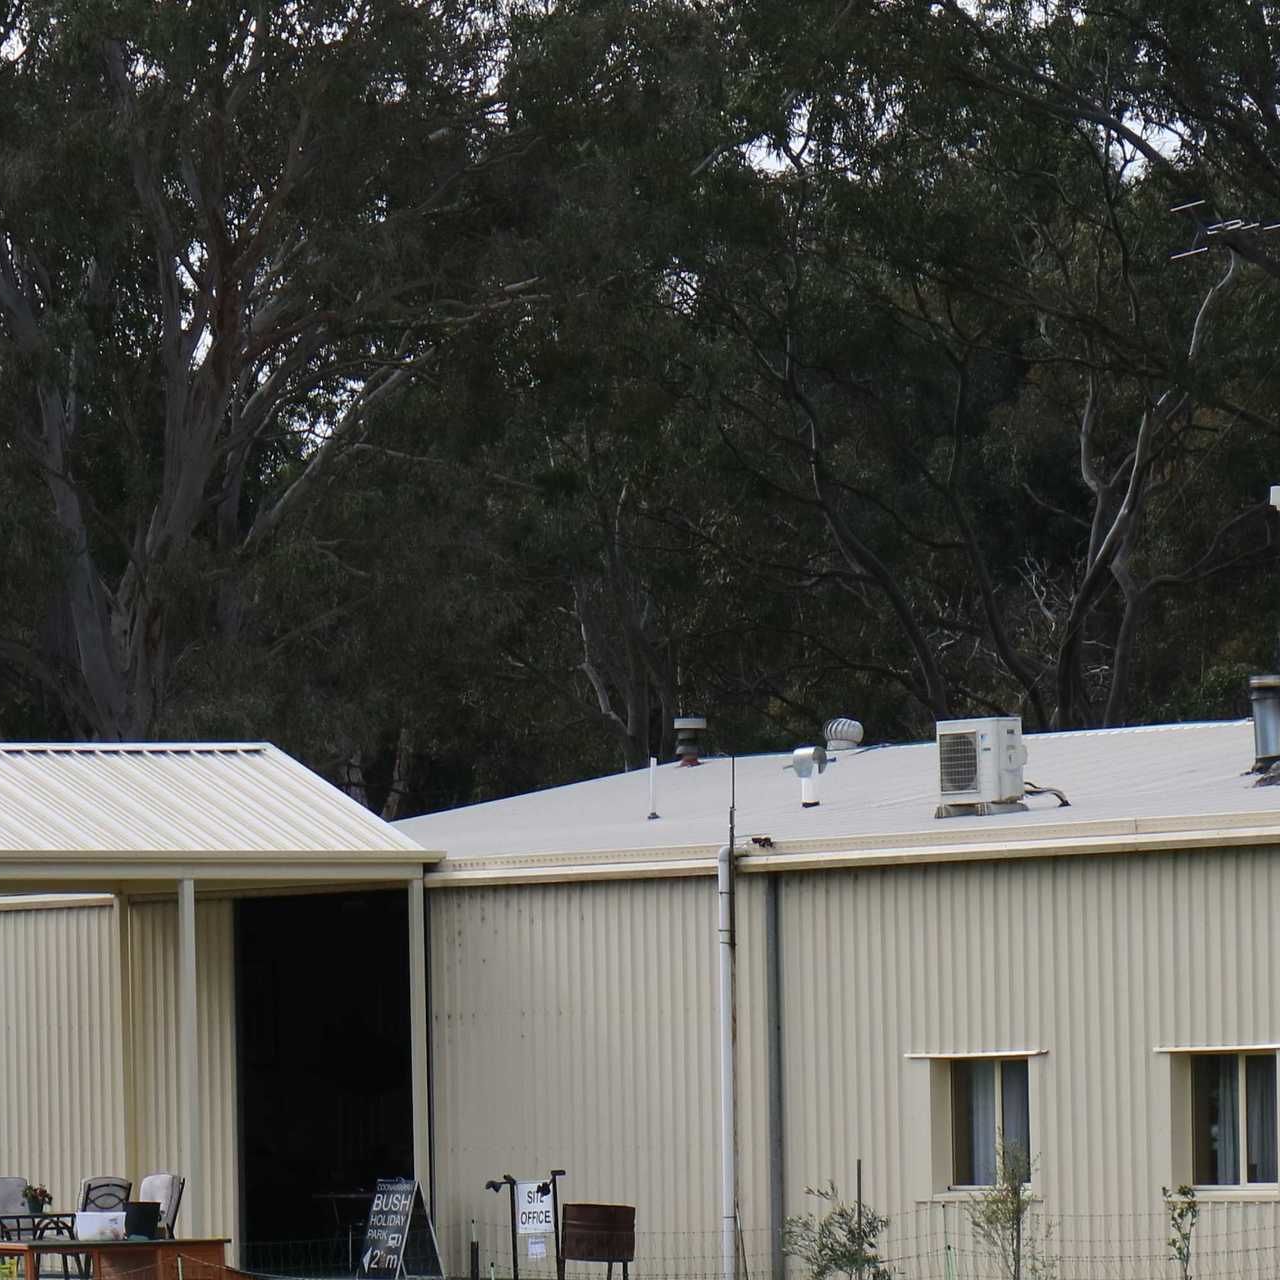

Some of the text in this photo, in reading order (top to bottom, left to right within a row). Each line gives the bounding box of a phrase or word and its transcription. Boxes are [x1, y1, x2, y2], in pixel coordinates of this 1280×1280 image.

[373, 1194, 411, 1211] BUSH
[370, 1215, 406, 1226] HOLIDAY
[520, 1211, 552, 1225] OFFICE
[367, 1229, 388, 1240] PARK
